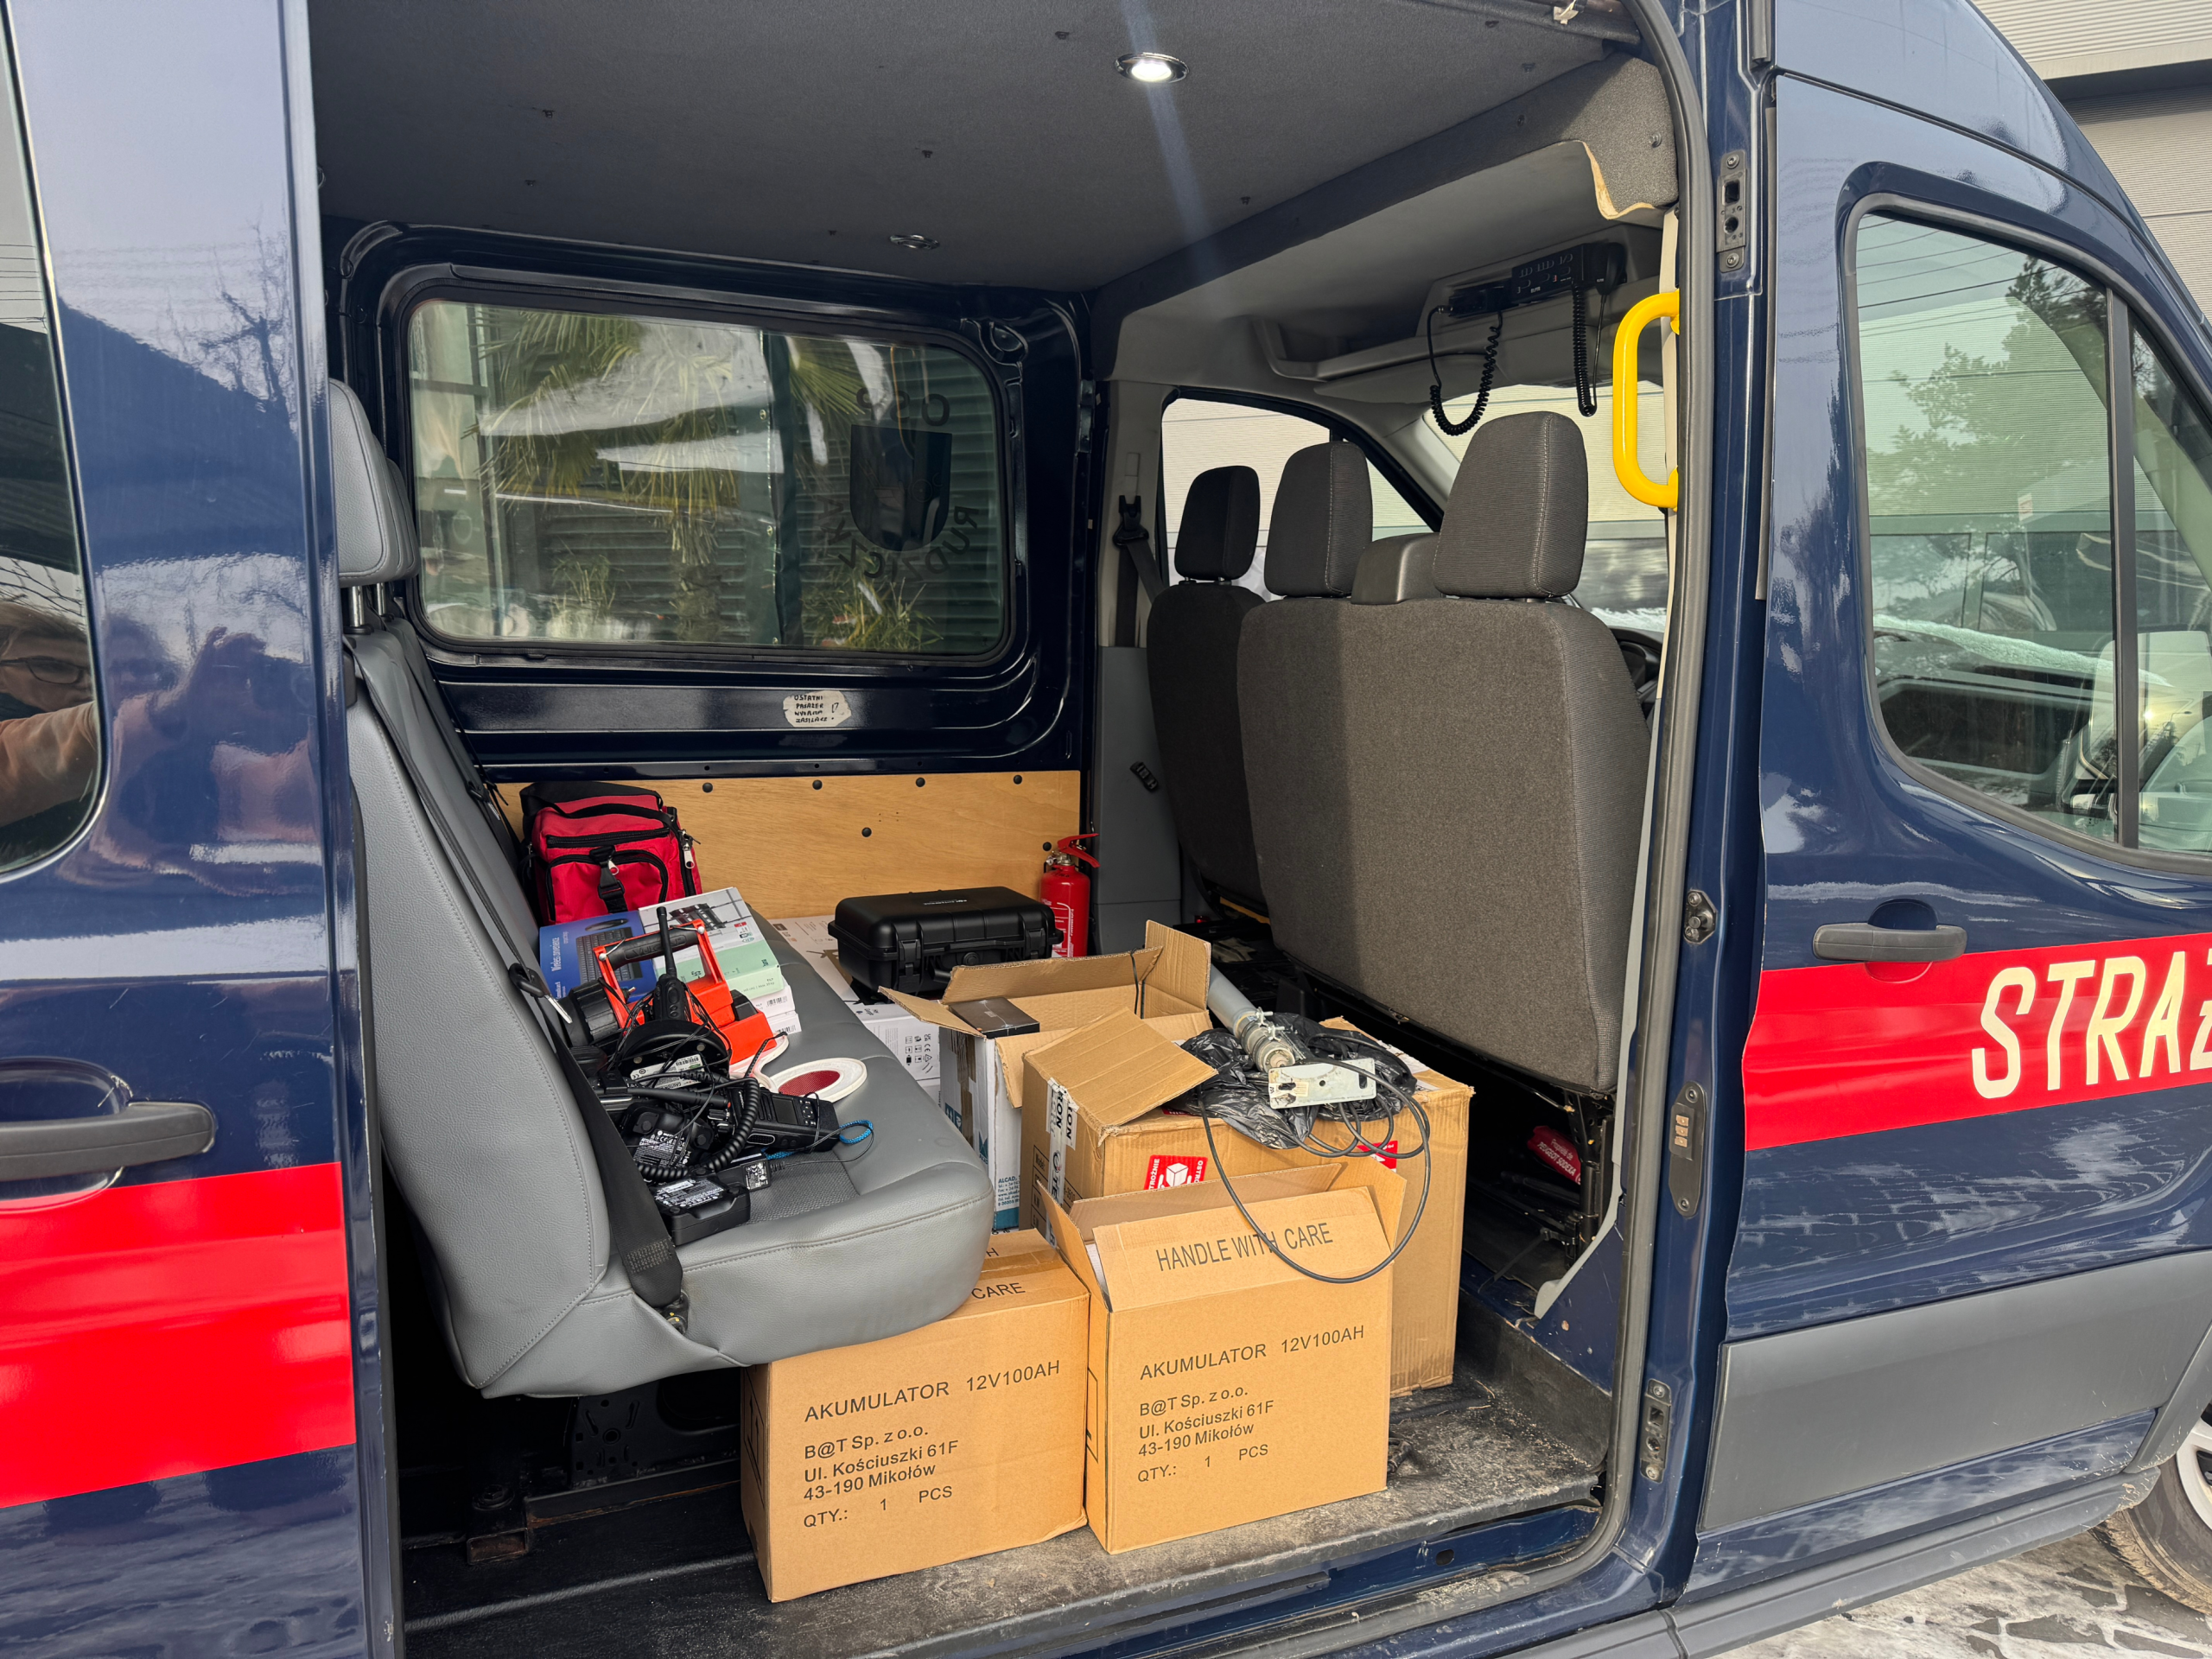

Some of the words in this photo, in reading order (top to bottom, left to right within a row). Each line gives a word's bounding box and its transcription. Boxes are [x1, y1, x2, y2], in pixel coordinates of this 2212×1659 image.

[1537, 1141, 1560, 1161] PEUGEOT
[1148, 1158, 1160, 1190] TROŻNIE
[1194, 1160, 1204, 1184] OSTRO
[1156, 1239, 1231, 1271] HANDLE
[1231, 1230, 1280, 1258] WITH
[1285, 1223, 1333, 1249] CARE
[971, 1283, 1026, 1299] CARE
[1141, 1344, 1266, 1380] AKUMULATOR
[1281, 1325, 1363, 1353] 12V100AH
[804, 1382, 949, 1422] AKUMULATOR
[967, 1360, 1058, 1391] 12V100AH
[1141, 1397, 1177, 1416] B@T
[1181, 1395, 1205, 1408] Sp.
[1209, 1392, 1217, 1402] z
[1221, 1387, 1249, 1400] o.o.
[1140, 1424, 1161, 1439] Ul.
[1164, 1406, 1243, 1433] Kościuszki
[1247, 1400, 1274, 1416] 61F
[805, 1439, 848, 1459] B@T
[852, 1435, 879, 1450] Sp.
[884, 1433, 893, 1443] z
[898, 1427, 928, 1440] o.o.
[1139, 1434, 1191, 1456] 43-190
[1195, 1424, 1254, 1445] Mikołów
[805, 1467, 827, 1482] Ul.
[831, 1446, 922, 1477] Kościuszki
[927, 1440, 958, 1457] 61F
[1138, 1465, 1176, 1482] QTY.:
[1205, 1456, 1210, 1467] 1
[1239, 1444, 1268, 1460] PCS
[804, 1477, 863, 1500] 43-190
[869, 1465, 936, 1488] Mikołów
[804, 1509, 847, 1527] QTY.:
[880, 1498, 886, 1510] 1
[919, 1486, 952, 1503] PCS
